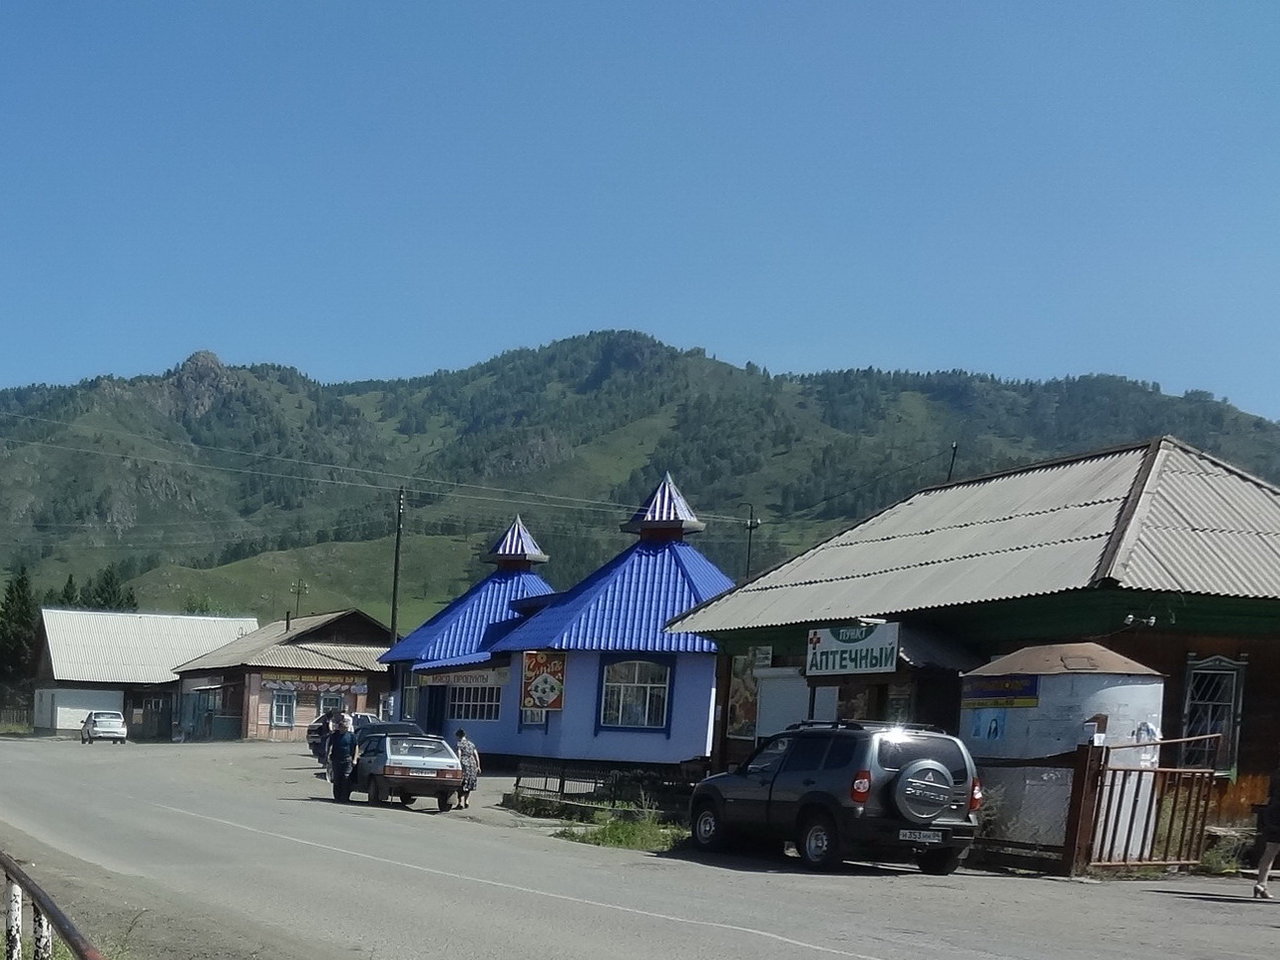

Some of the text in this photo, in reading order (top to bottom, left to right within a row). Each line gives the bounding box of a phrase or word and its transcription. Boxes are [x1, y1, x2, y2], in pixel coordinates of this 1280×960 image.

[840, 628, 866, 640] ПУНКТ
[809, 642, 895, 671] АПТЕЧНЫЙ
[453, 674, 489, 684] ПРОДУКТЫ
[906, 787, 949, 801] CHEVROLET
